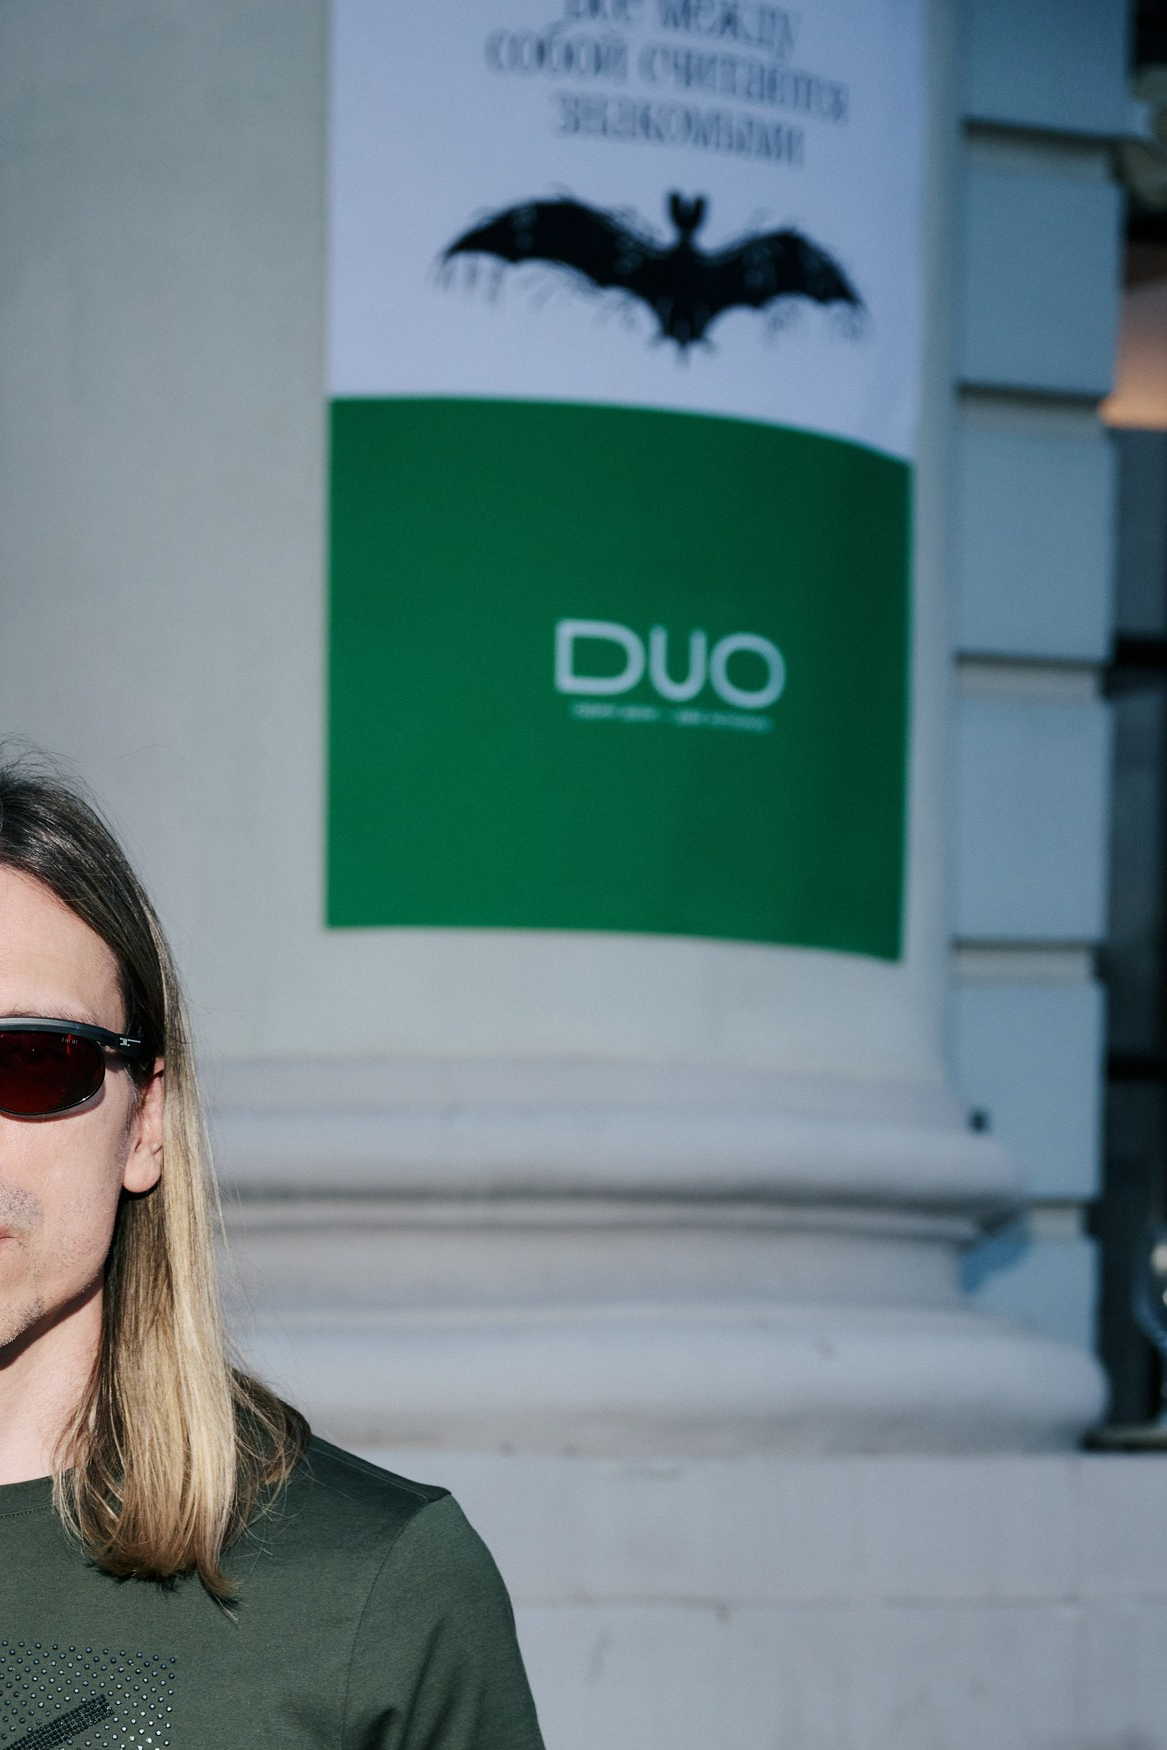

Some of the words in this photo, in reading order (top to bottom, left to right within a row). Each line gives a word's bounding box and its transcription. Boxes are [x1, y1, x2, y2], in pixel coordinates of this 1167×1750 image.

[485, 19, 629, 82] собой
[638, 39, 849, 126] считаются
[552, 90, 805, 166] знакомыми
[554, 618, 787, 711] DUO
